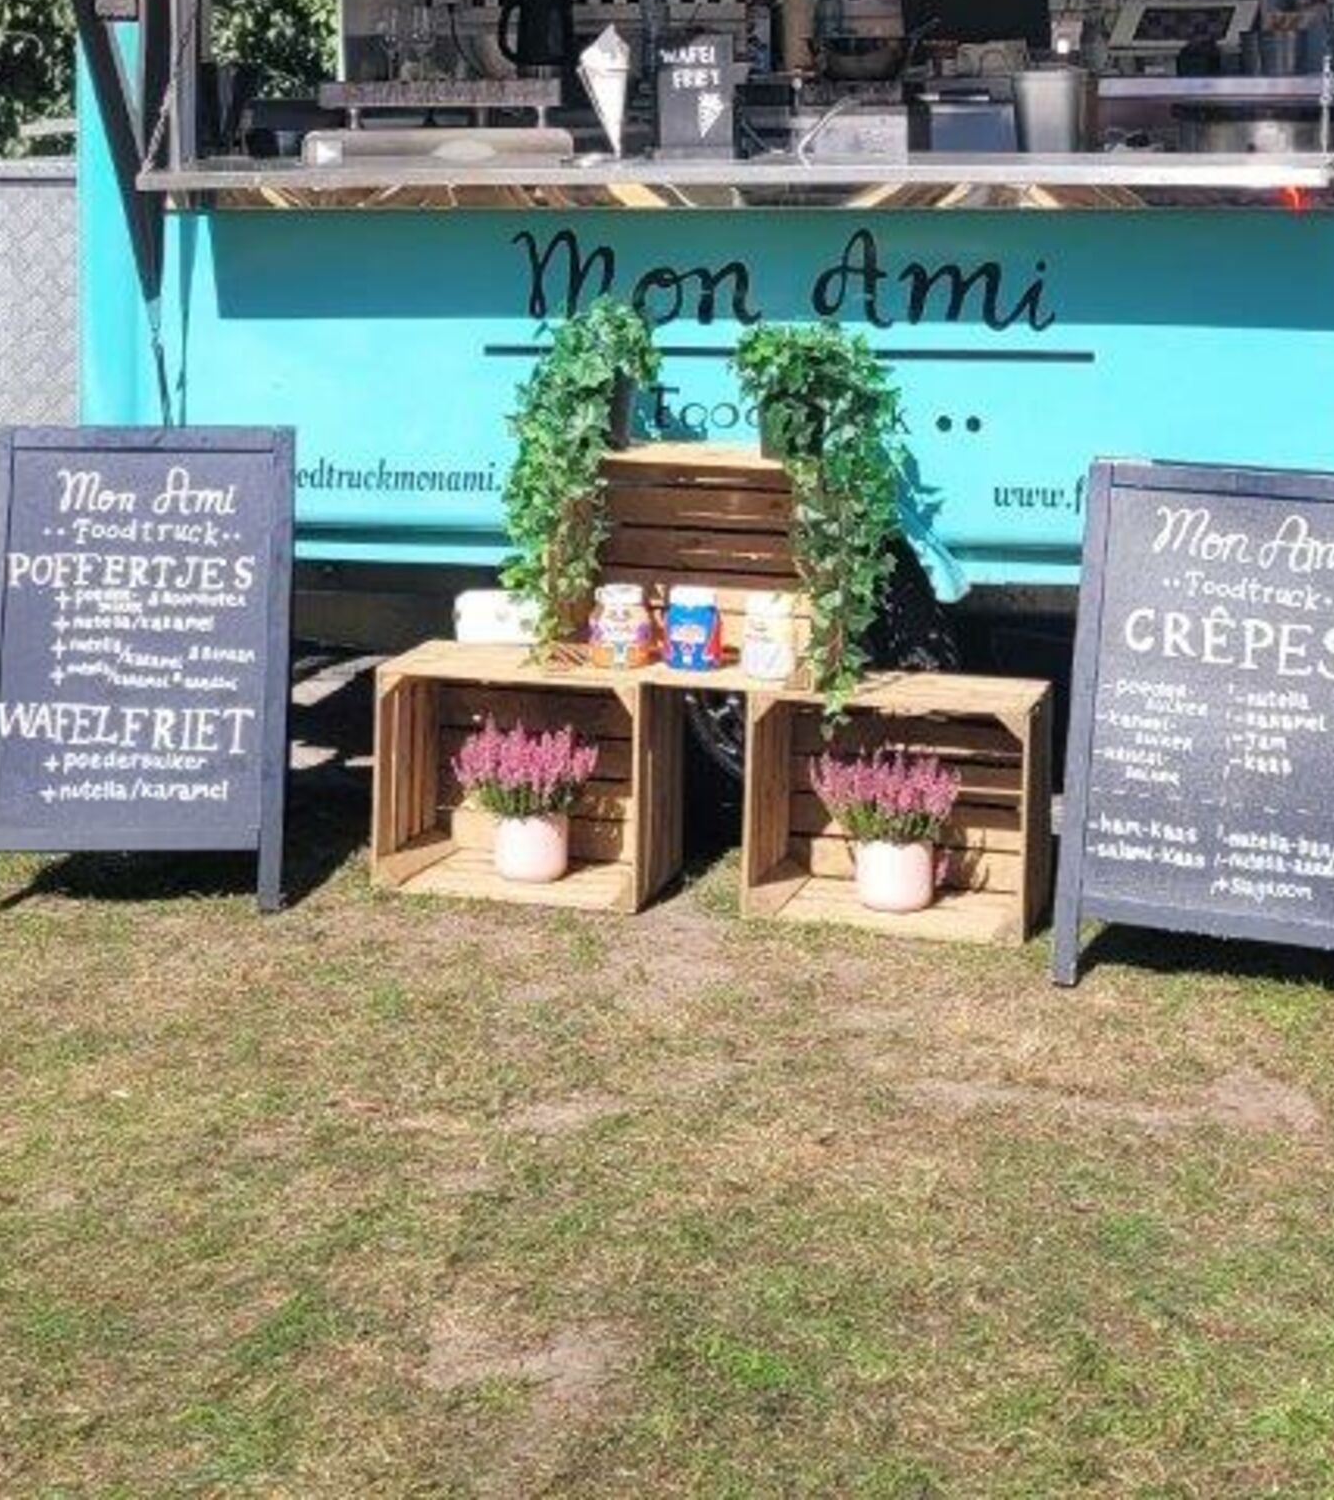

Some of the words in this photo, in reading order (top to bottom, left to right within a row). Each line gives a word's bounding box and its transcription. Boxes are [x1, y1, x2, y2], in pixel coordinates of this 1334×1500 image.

[512, 229, 762, 327] Mon
[812, 228, 1055, 332] Ami
[57, 469, 135, 513] Mon
[152, 467, 237, 514] Ami
[1152, 505, 1251, 565] Mon
[8, 552, 255, 591] POFFERTJES
